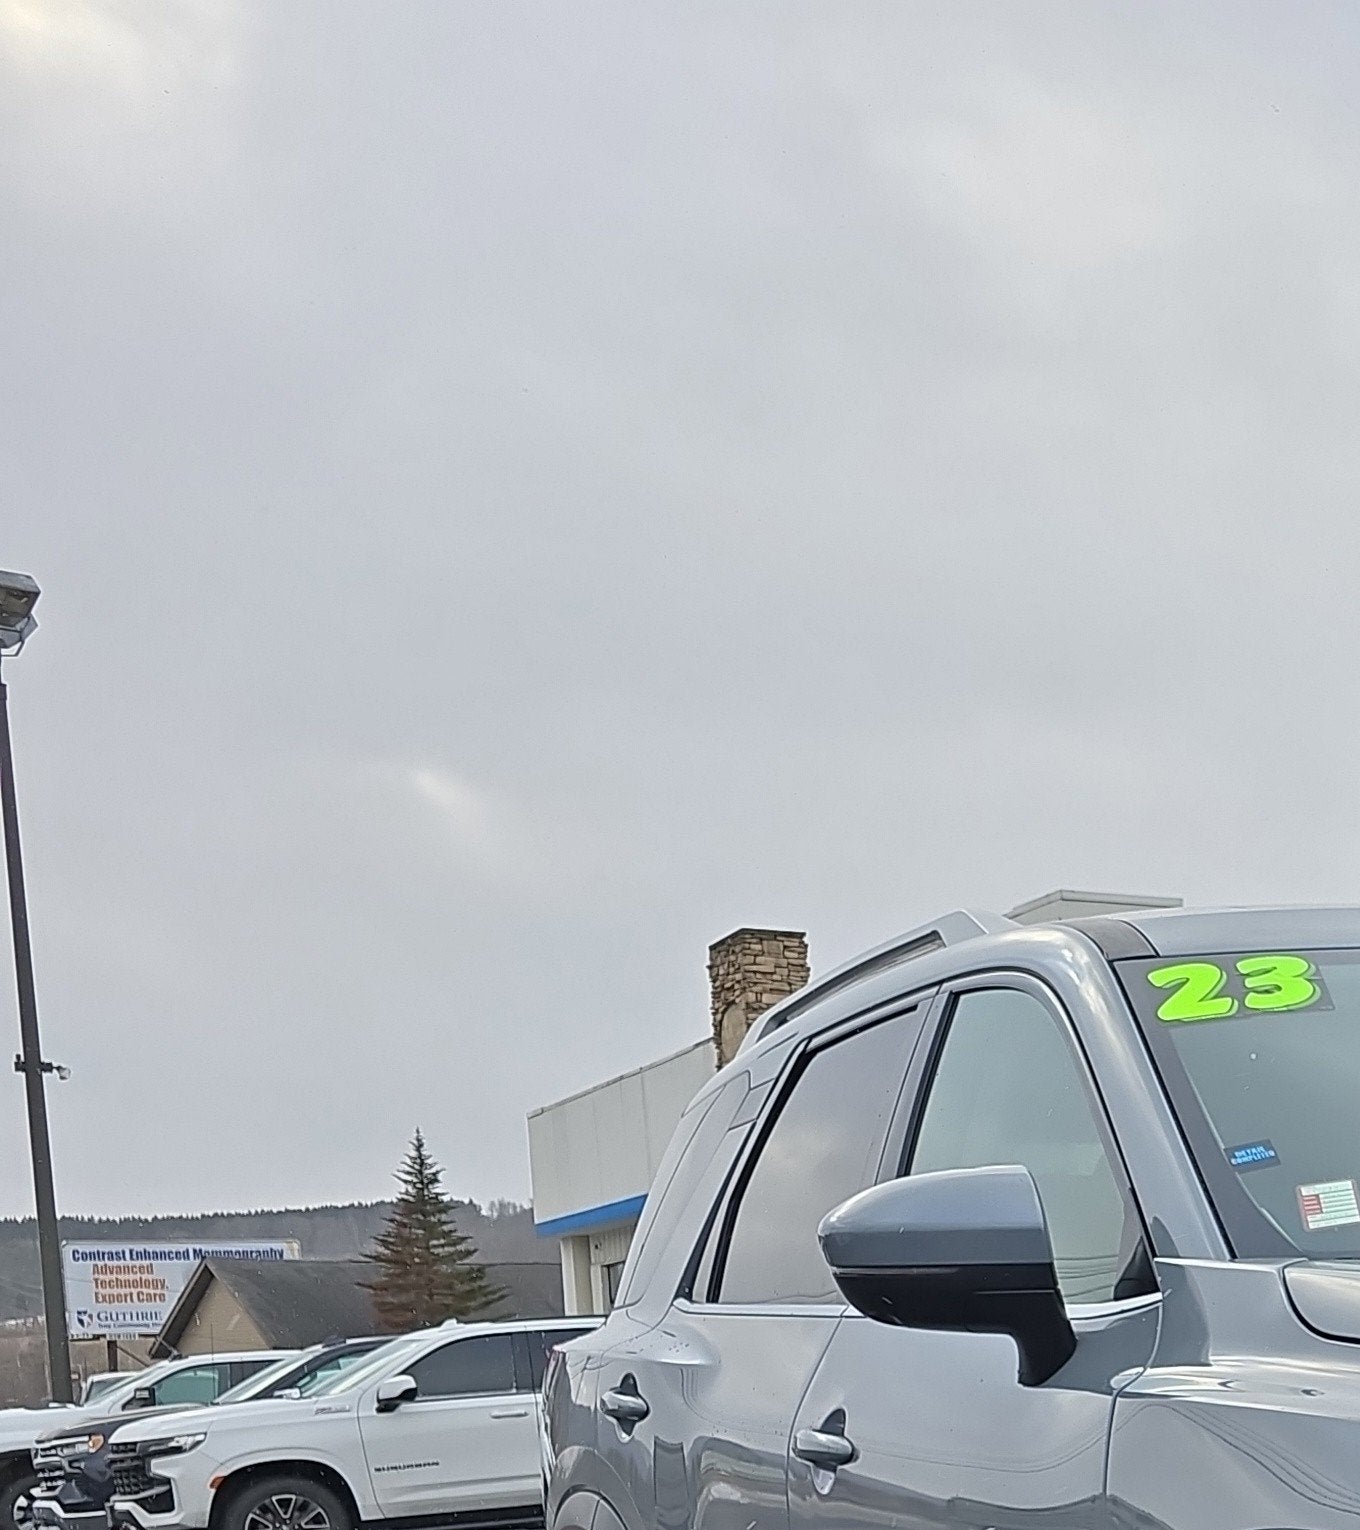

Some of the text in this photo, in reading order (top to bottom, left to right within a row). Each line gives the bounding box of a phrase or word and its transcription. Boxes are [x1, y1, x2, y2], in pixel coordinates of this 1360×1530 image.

[1147, 955, 1321, 1022] 23
[72, 1248, 127, 1263] Contrast
[129, 1247, 190, 1262] Enhanced
[92, 1262, 154, 1276] Advanced
[94, 1291, 166, 1305] Expert Care
